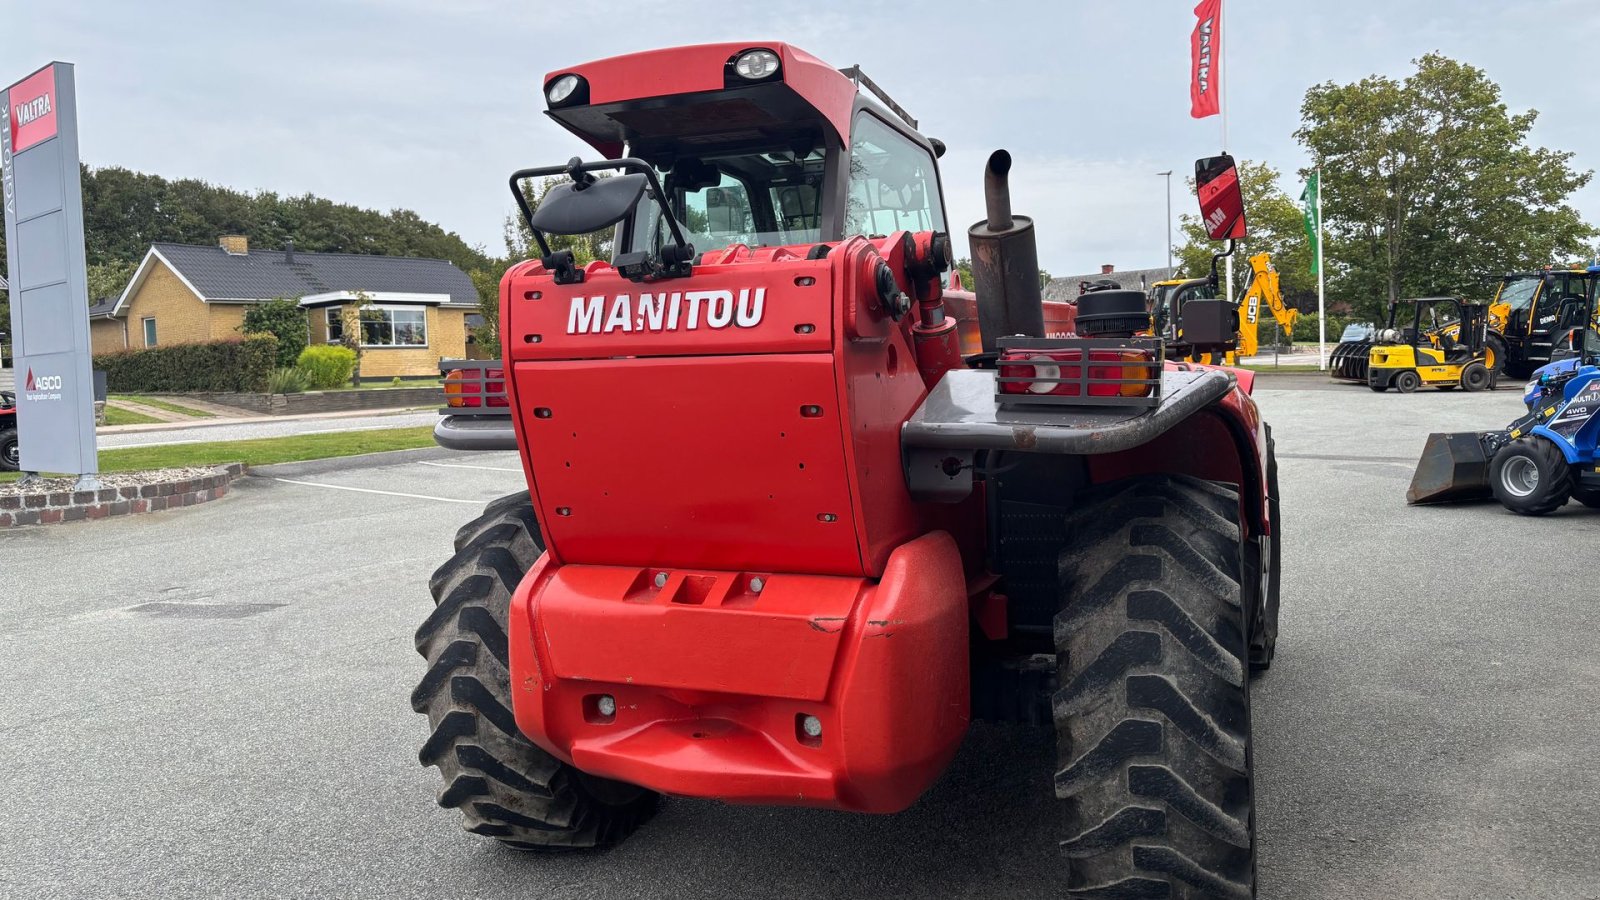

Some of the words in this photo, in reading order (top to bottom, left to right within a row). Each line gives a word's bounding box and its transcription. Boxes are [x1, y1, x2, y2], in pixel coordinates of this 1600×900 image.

[16, 92, 51, 127] VALTRA
[1, 103, 14, 214] AGROTEK
[567, 288, 767, 334] MANITOU
[1247, 296, 1258, 324] JCB
[1539, 314, 1556, 325] DEMO
[36, 375, 62, 390] AGCO
[1566, 407, 1587, 415] 4WD
